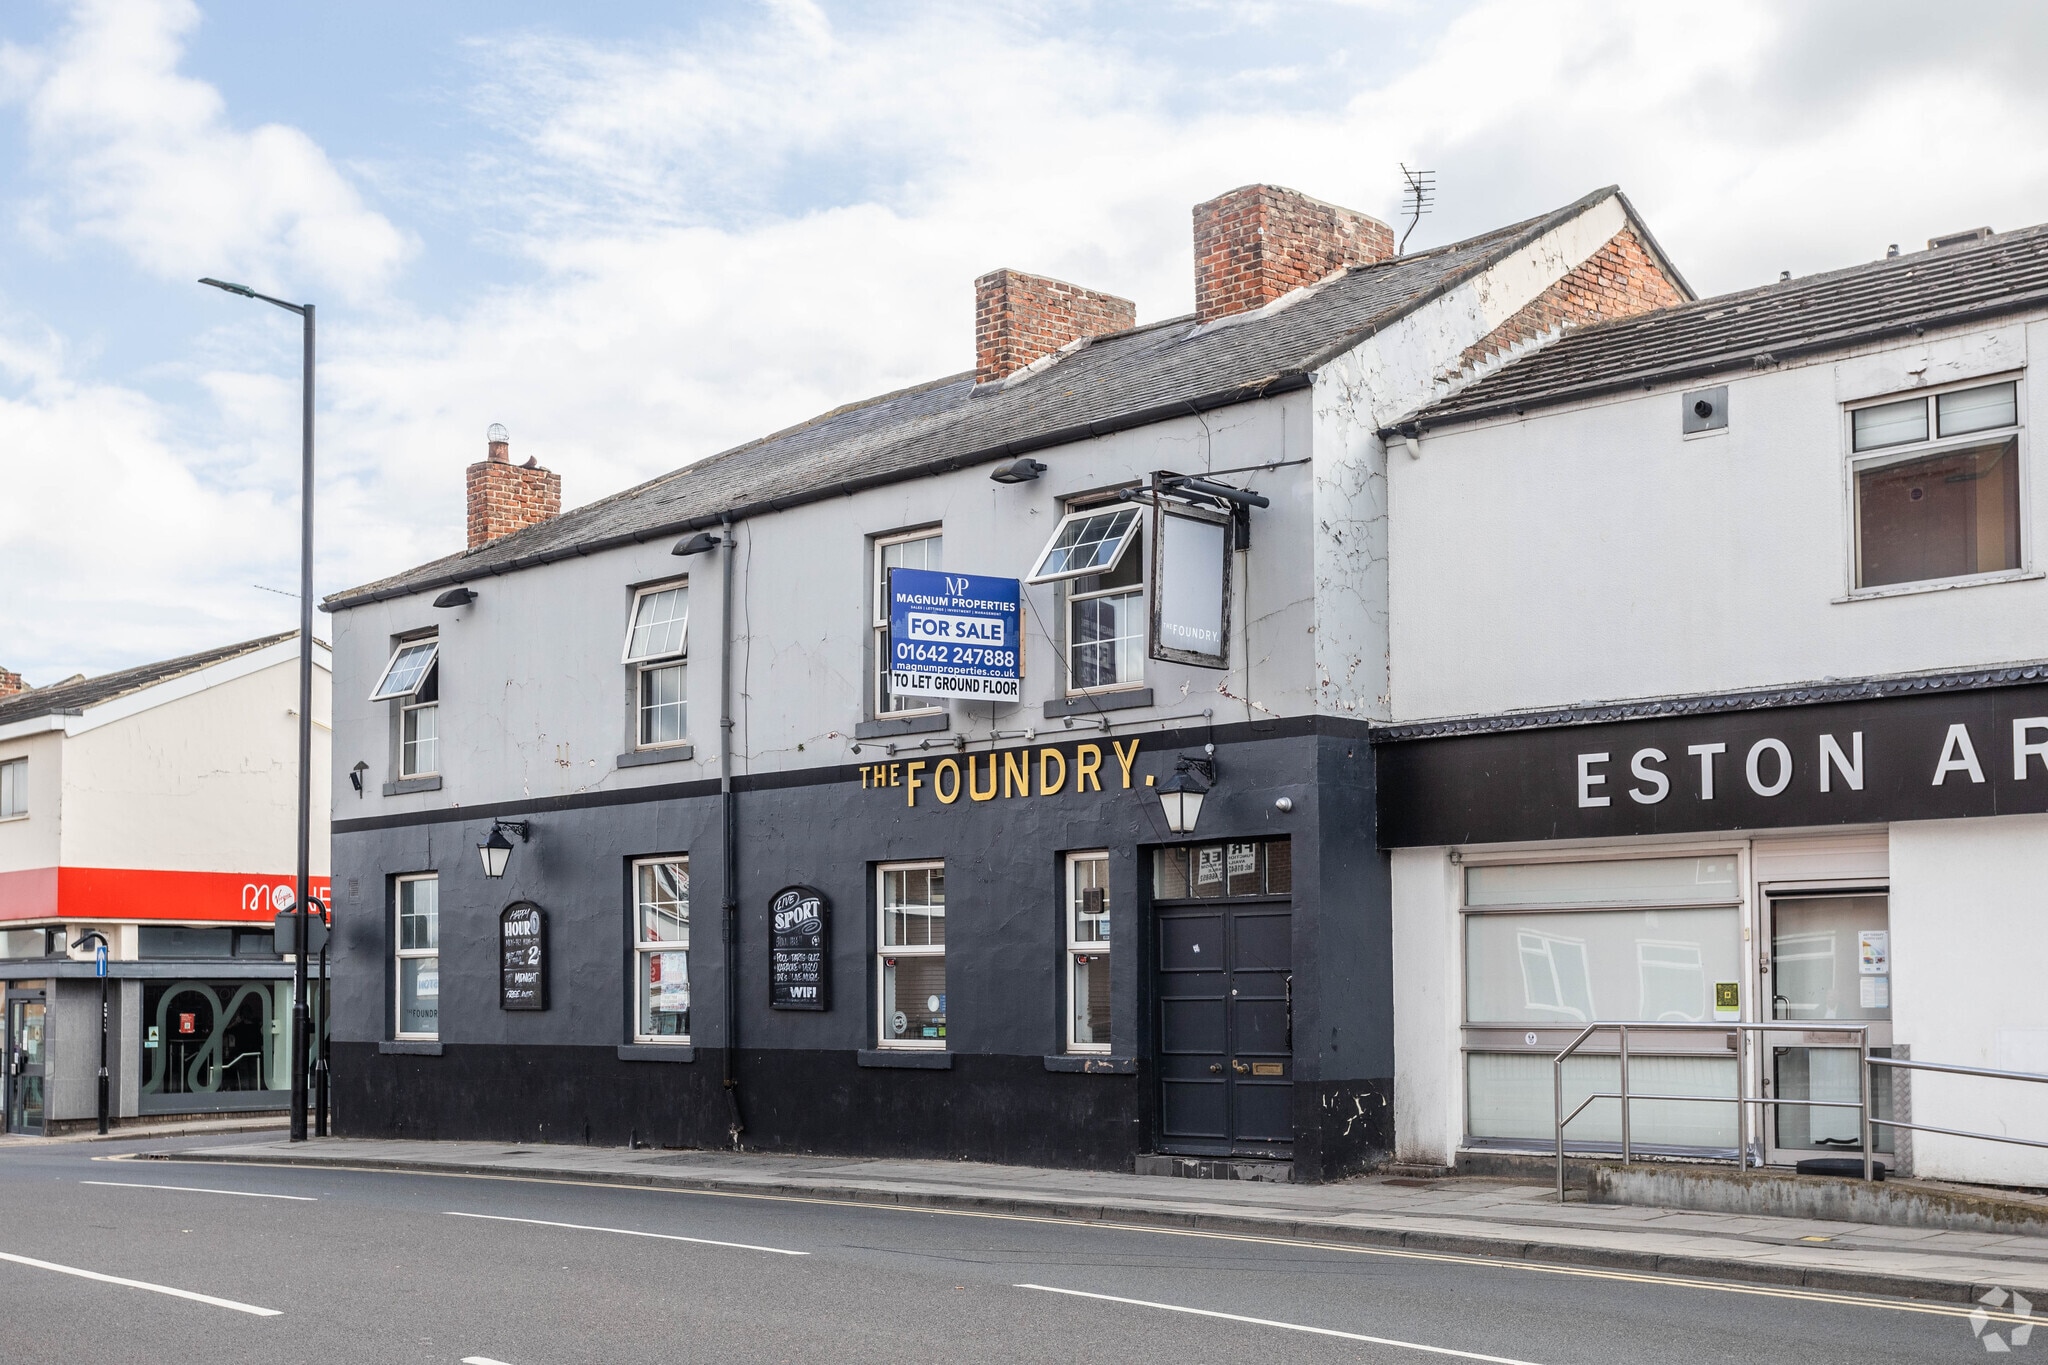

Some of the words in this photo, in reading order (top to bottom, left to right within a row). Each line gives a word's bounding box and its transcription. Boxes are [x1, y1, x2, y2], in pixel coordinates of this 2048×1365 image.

[896, 593, 948, 606] MAGNUM
[952, 598, 1016, 612] PROPERTIES
[911, 619, 950, 636] FOR
[955, 622, 1002, 641] SALE
[897, 643, 948, 662] 01642
[953, 647, 1014, 667] 247888
[897, 662, 1015, 678] magnumproperties.co.uk
[894, 673, 908, 688] TO
[912, 675, 931, 689] LET
[935, 677, 979, 692] GROUND
[983, 680, 1017, 695] FLOOR
[859, 763, 900, 789] THE
[1577, 731, 1864, 808] ESTON
[275, 889, 292, 906] Virgin
[777, 894, 795, 910] LIVE
[774, 900, 820, 930] SPORT
[504, 921, 531, 937] HOUR
[789, 986, 817, 998] WIFI
